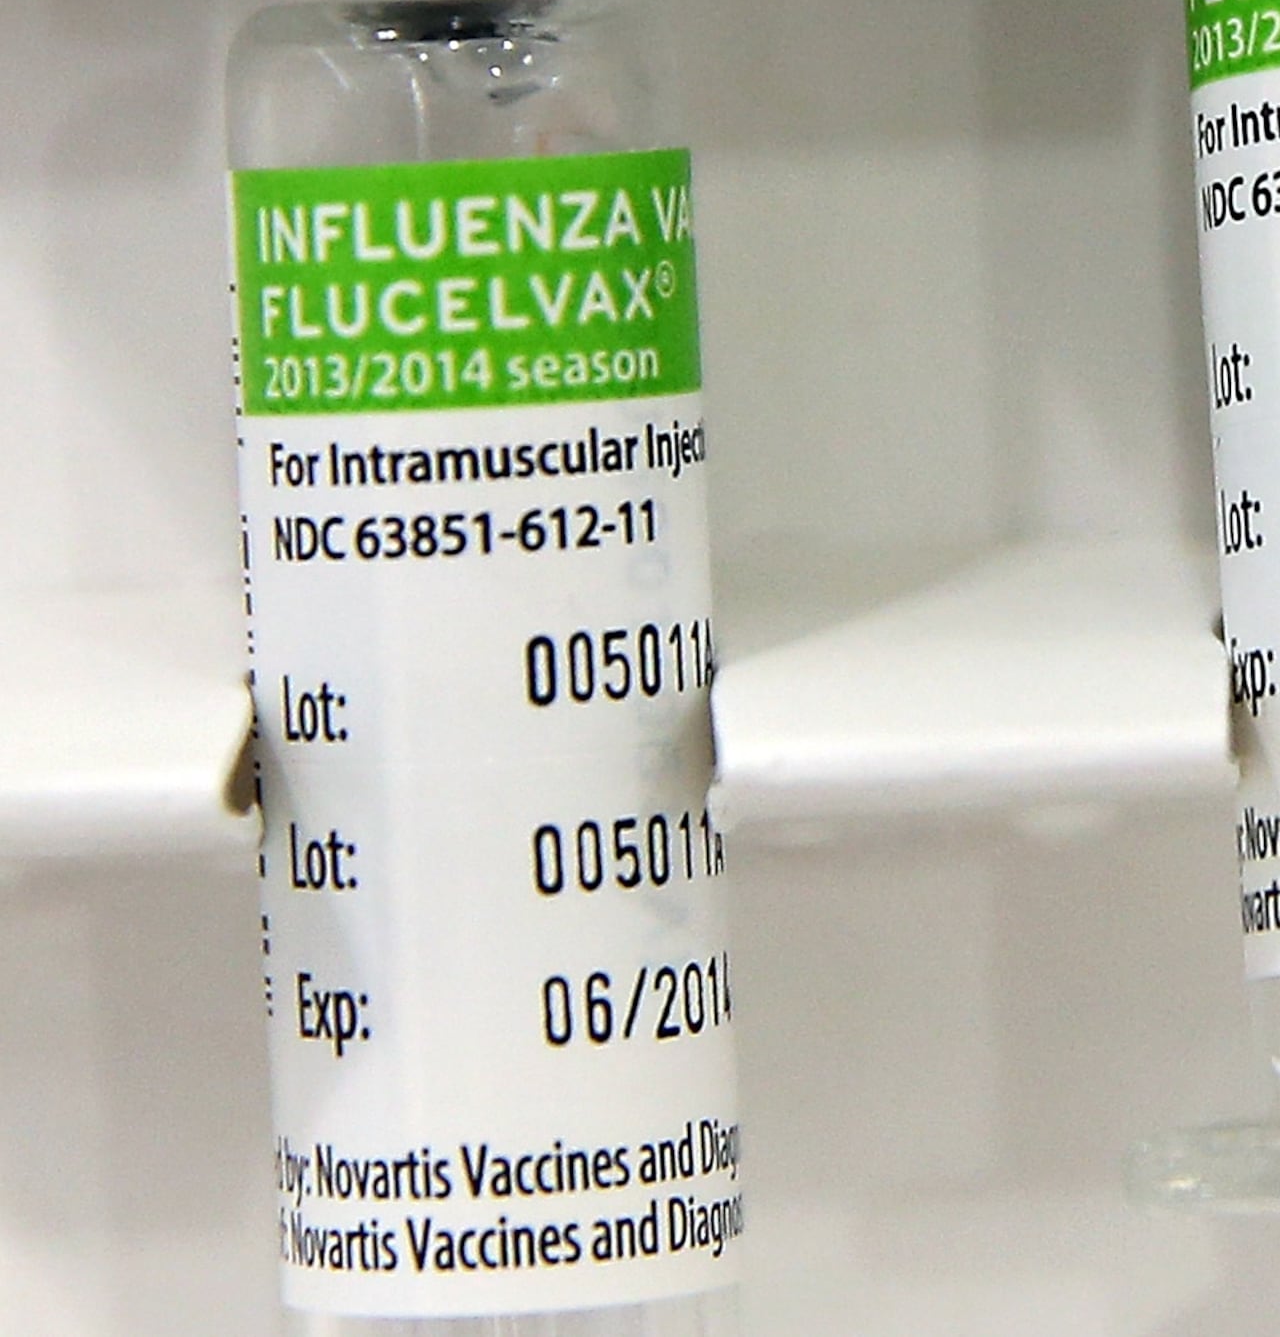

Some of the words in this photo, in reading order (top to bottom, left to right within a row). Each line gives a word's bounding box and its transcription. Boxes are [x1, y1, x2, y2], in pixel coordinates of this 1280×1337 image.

[1198, 112, 1225, 160] For
[257, 189, 642, 262] INFLUENZA
[1201, 177, 1246, 232] NDC
[264, 348, 493, 398] 2013/2014
[506, 347, 660, 390] season
[1212, 343, 1252, 409] Lot:
[269, 443, 319, 487] For
[330, 428, 638, 486] Intramuscular
[275, 517, 345, 561] NDC
[356, 500, 657, 558] 63851-612-11
[1222, 489, 1263, 555] Lot:
[282, 675, 348, 742] Lot:
[289, 823, 357, 889] Lot:
[297, 973, 371, 1056] Exp:
[316, 1147, 449, 1201] Novartis
[462, 1143, 629, 1198] Vaccines
[640, 1122, 693, 1181] and
[289, 1212, 397, 1272] Novartis
[408, 1216, 581, 1274] Vaccines
[593, 1200, 657, 1259] and
